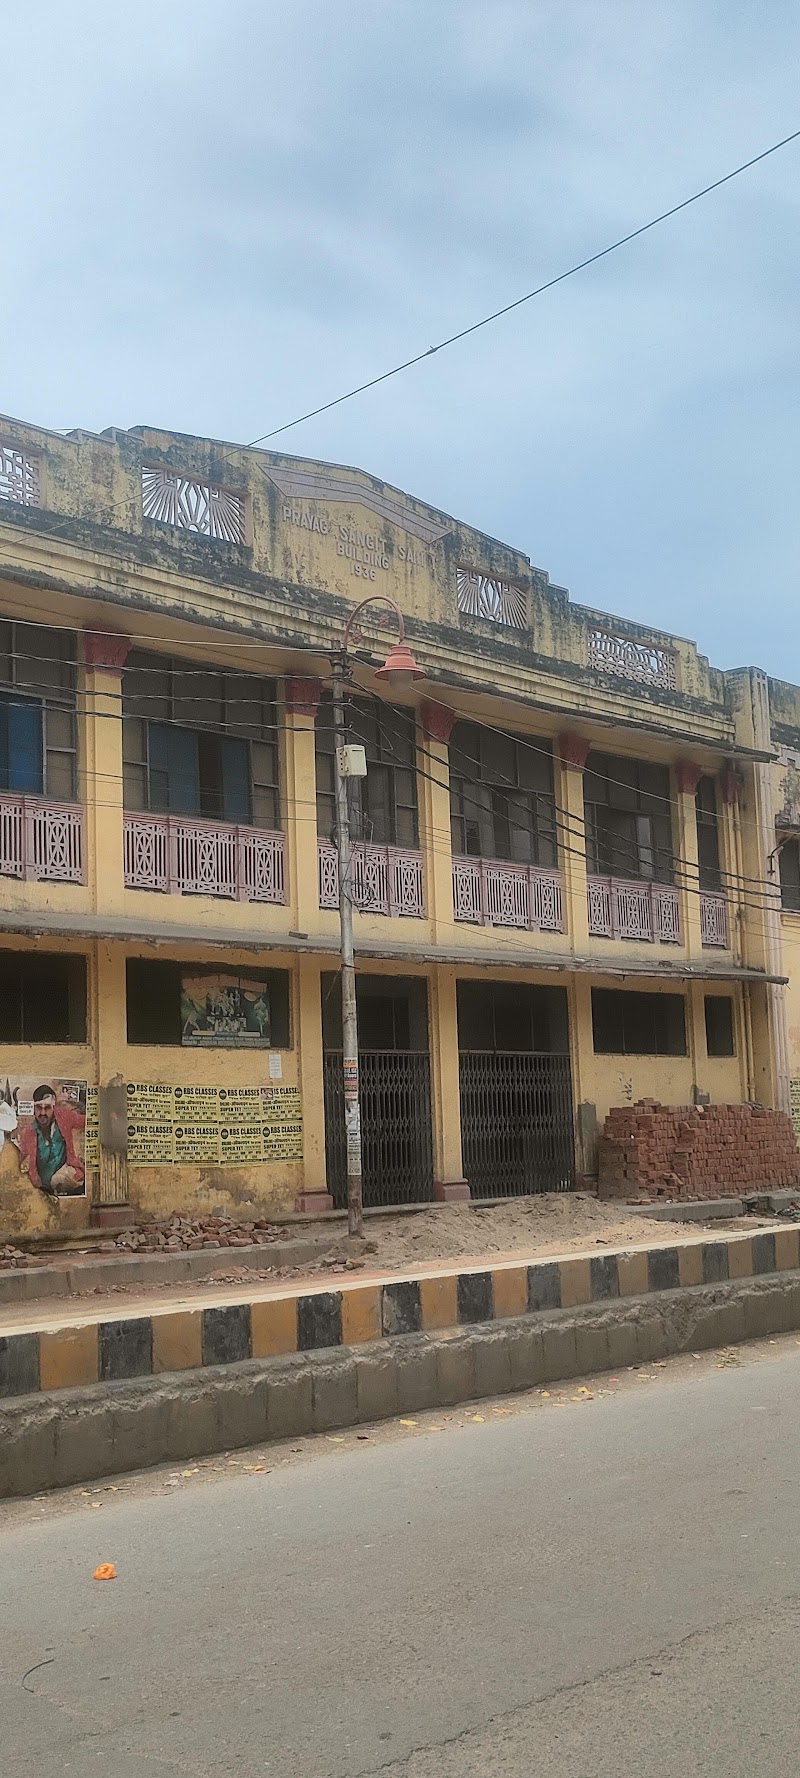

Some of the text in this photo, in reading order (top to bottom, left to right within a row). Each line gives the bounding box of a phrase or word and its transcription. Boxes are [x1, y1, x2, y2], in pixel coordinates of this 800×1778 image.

[281, 505, 328, 534] PRAYAG
[340, 526, 387, 554] SANGIT
[337, 541, 389, 570] BUILDING
[350, 562, 377, 581] 1936
[149, 1126, 173, 1134] CLASSES
